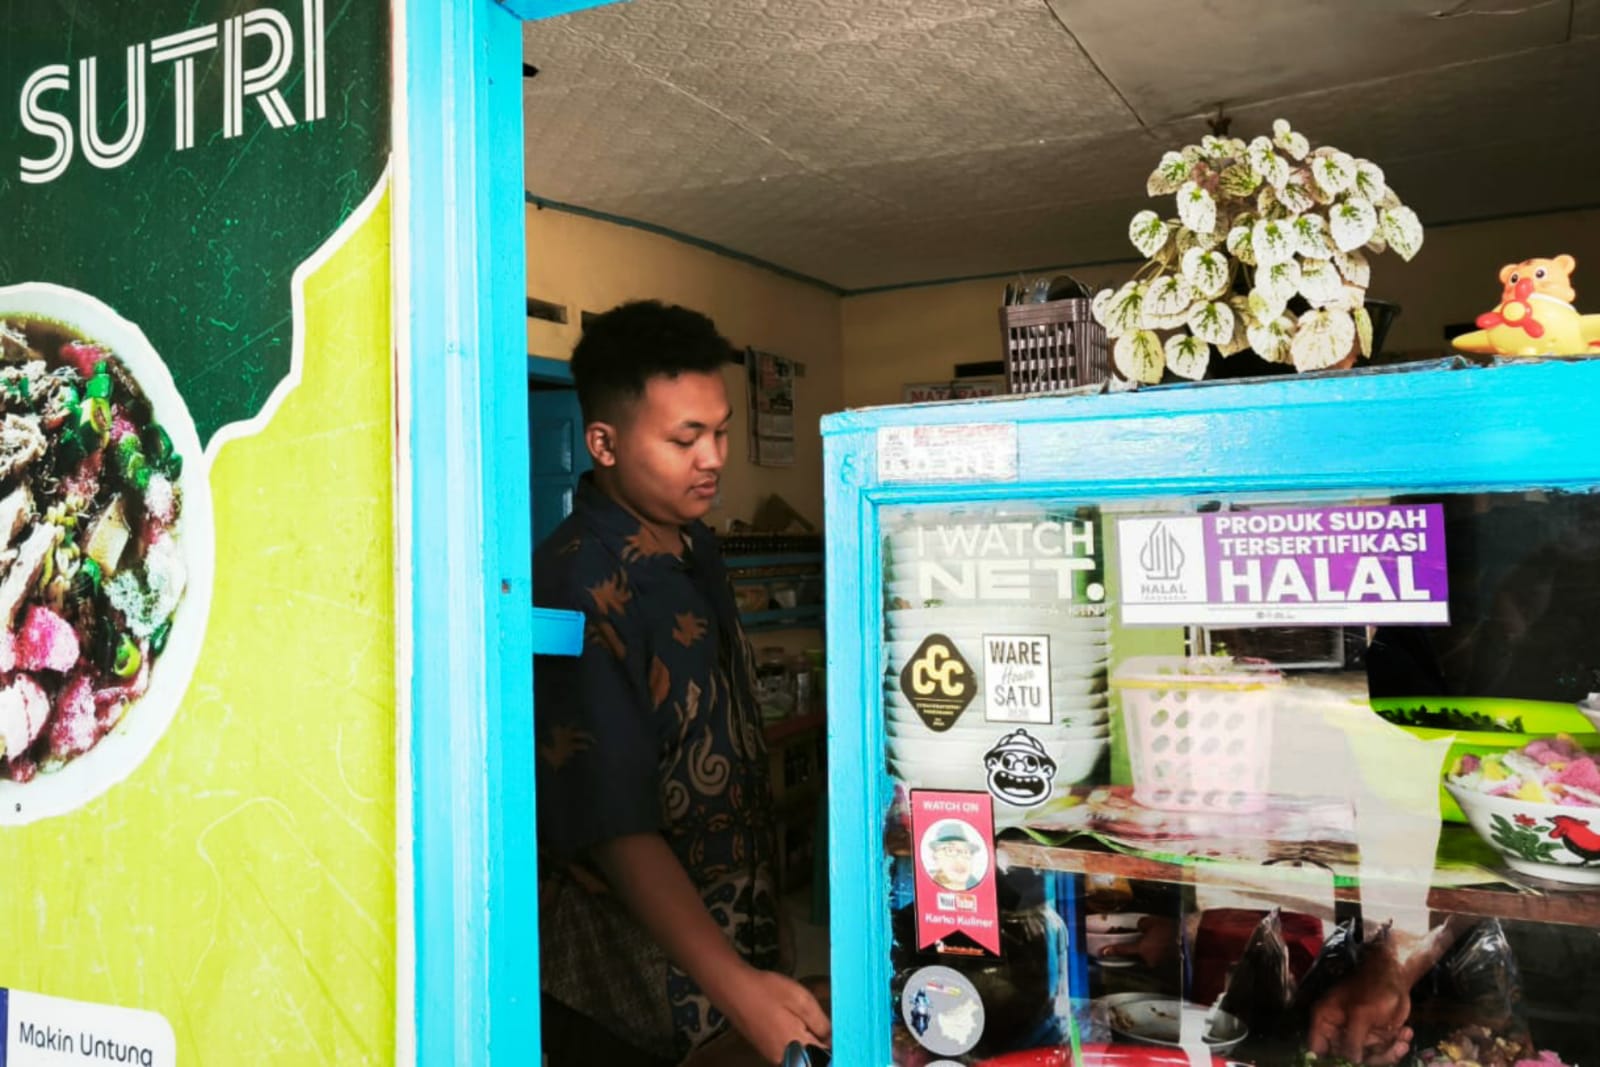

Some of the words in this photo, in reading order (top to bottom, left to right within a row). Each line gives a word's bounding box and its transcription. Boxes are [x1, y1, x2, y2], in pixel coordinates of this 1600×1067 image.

[20, 0, 326, 184] SUTRI
[1215, 512, 1324, 535] PRODUK
[1329, 508, 1427, 530] SUDAH
[916, 525, 925, 557] I
[936, 520, 1095, 557] WATCH
[1218, 532, 1427, 557] TERSERTIFIKASI
[918, 557, 1105, 601] NET.
[1140, 583, 1188, 595] HALAL
[1219, 555, 1431, 602] HALAL
[989, 640, 1042, 665] WARE
[994, 684, 1041, 707] SATU
[922, 800, 960, 812] WATCH
[962, 802, 979, 813] ON
[19, 1021, 74, 1053] Makin
[80, 1031, 153, 1067] Untung
